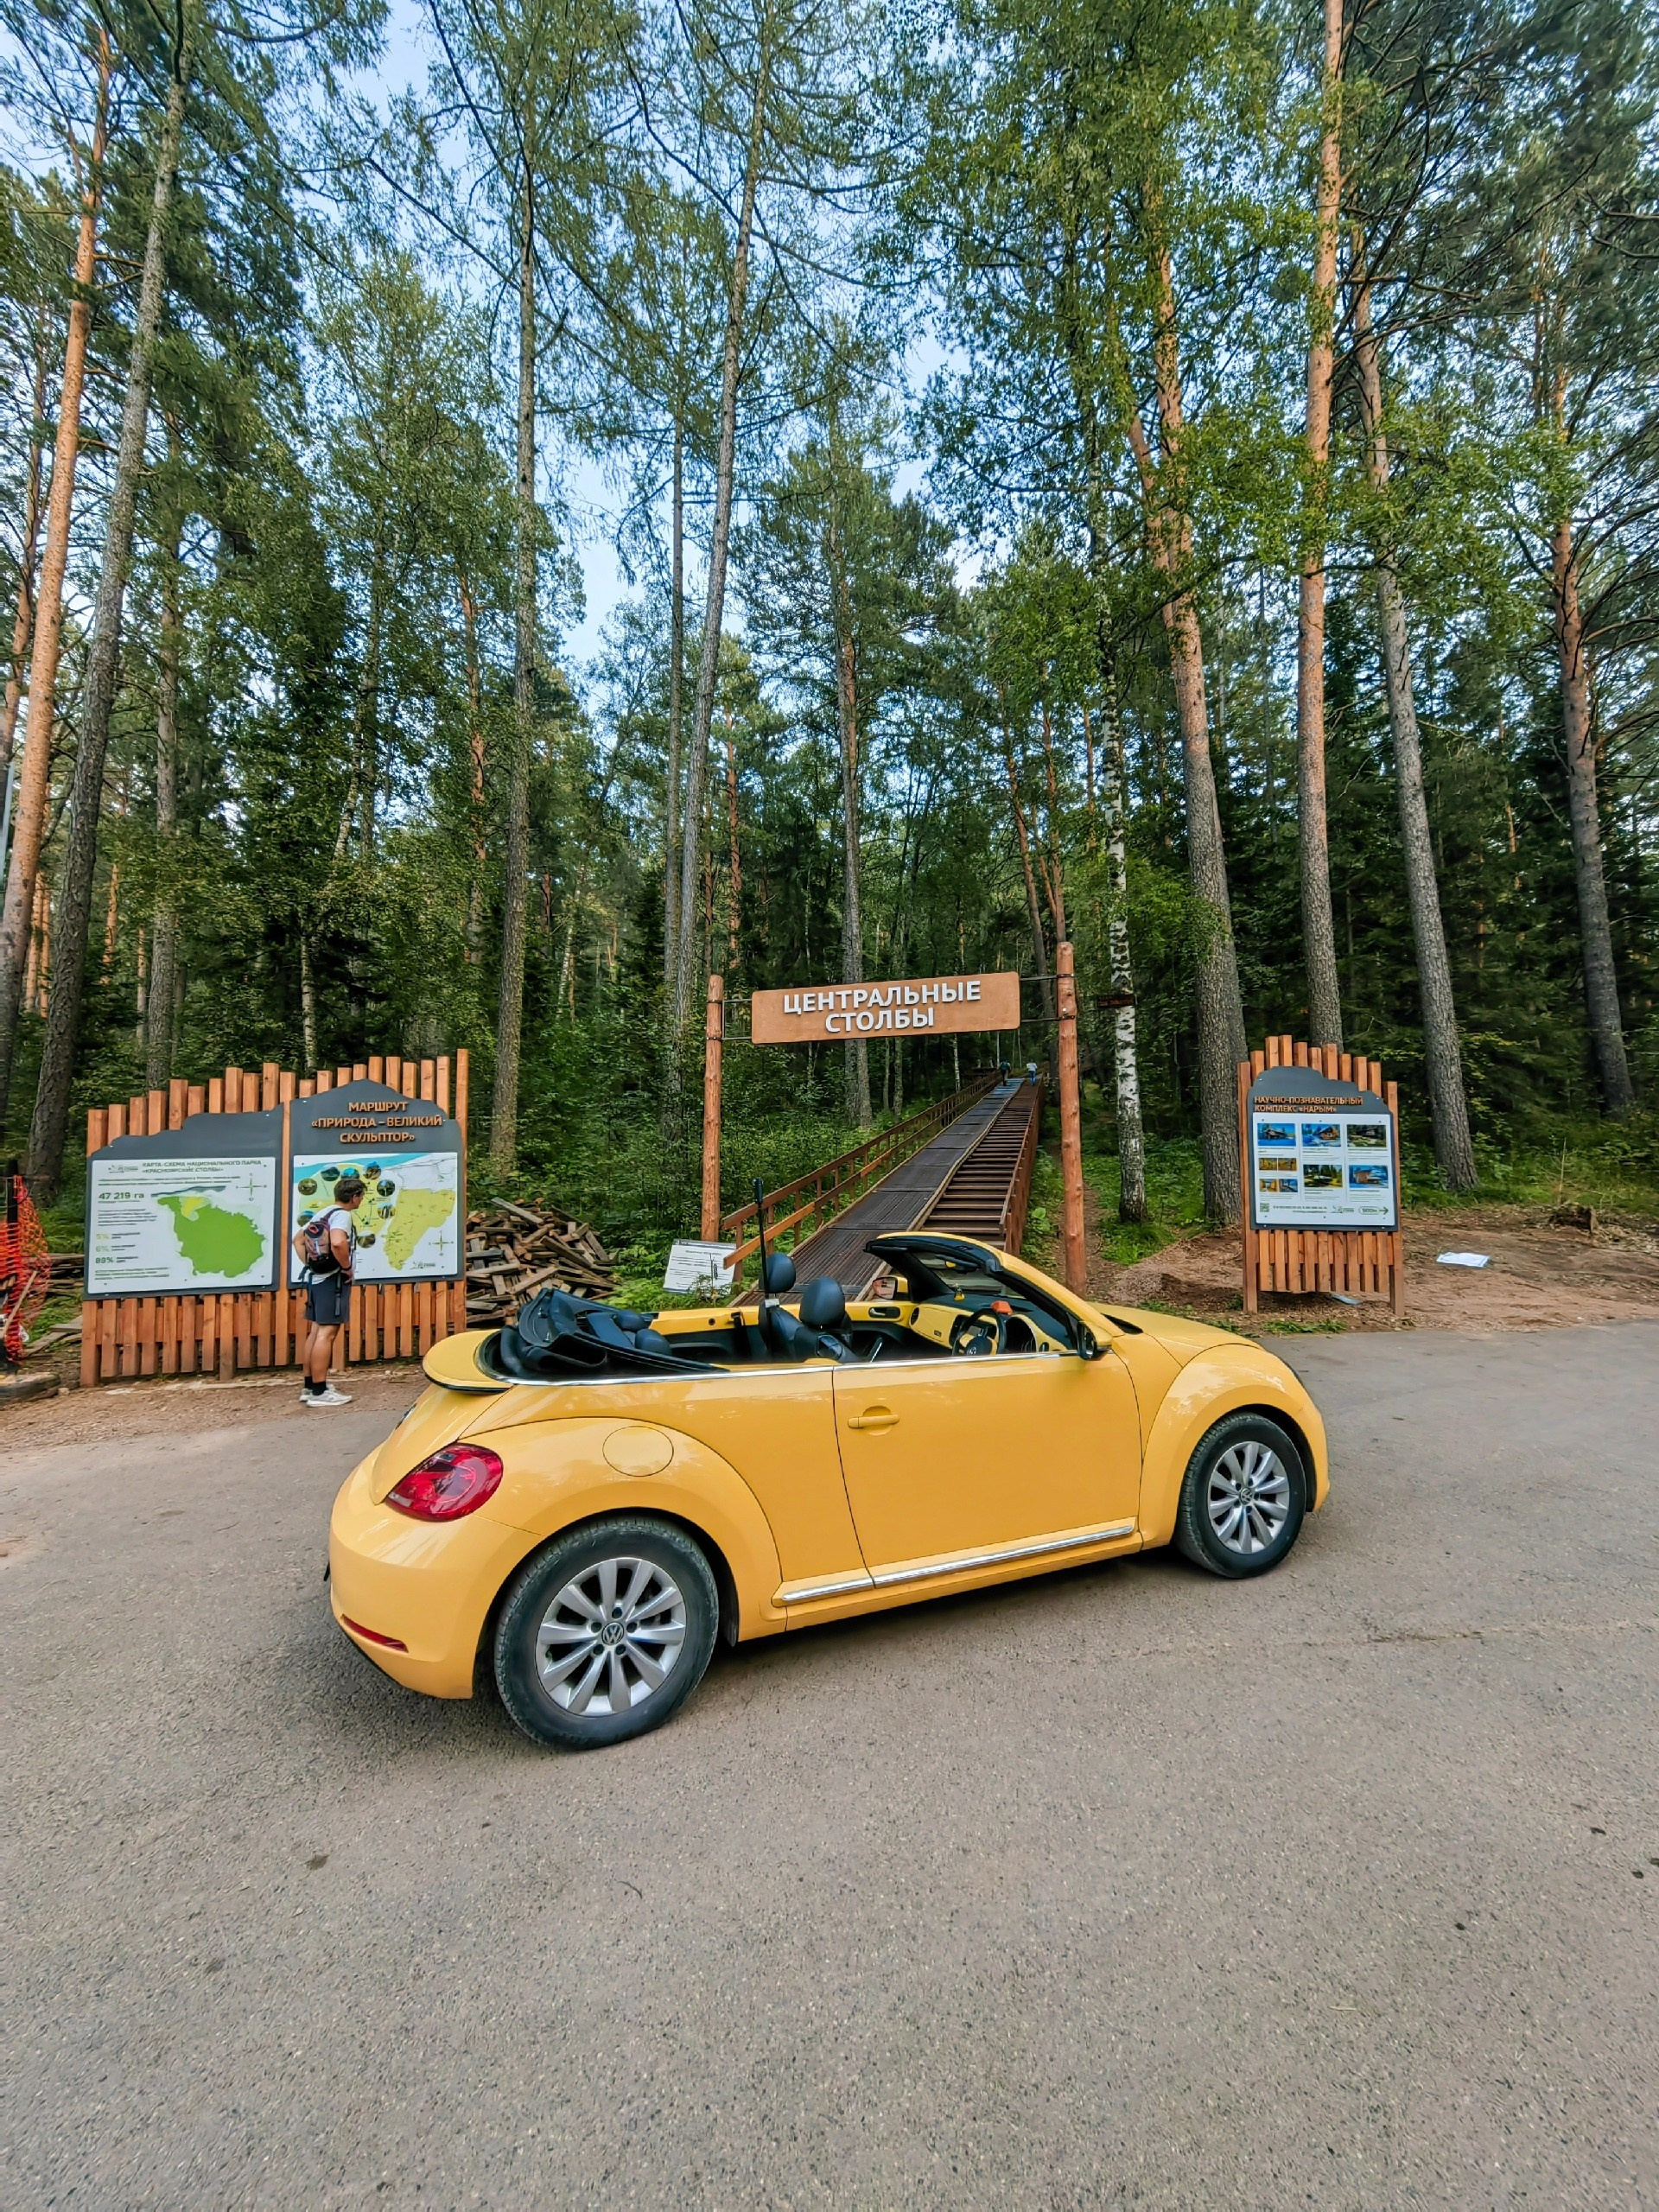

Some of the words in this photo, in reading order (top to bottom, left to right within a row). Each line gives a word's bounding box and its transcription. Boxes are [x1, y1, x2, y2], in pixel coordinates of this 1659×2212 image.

[783, 980, 981, 1015] ЦЕНТРАЛЬНЫЕ
[824, 1007, 934, 1033] СТОЛБЫ
[348, 1101, 409, 1112] МАРШРУТ
[1254, 1096, 1363, 1105] НАУЧНО-ПОЗНАВАТЕЛЬНЫЙ
[311, 1116, 377, 1128] «ПРИРОДА
[386, 1114, 442, 1127] ВЕЛИКИЙ
[340, 1131, 415, 1143] СКУЛЬПТОР»
